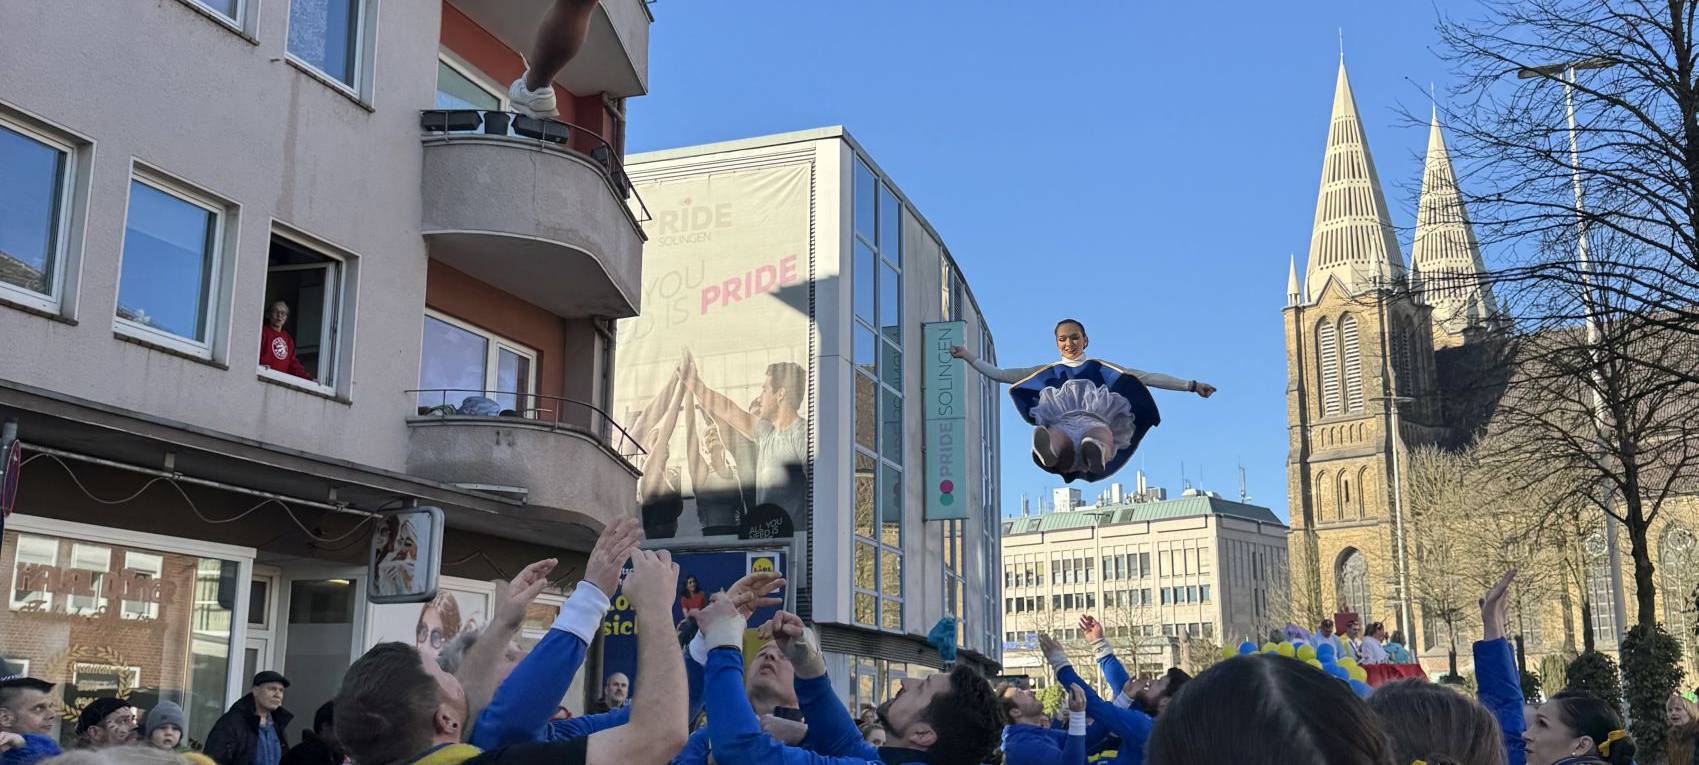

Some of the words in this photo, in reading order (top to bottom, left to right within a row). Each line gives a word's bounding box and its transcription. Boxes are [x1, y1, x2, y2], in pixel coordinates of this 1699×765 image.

[657, 232, 711, 248] SOLINGEN
[645, 259, 705, 306] YOU
[701, 254, 798, 315] PRIDE
[938, 328, 953, 417] SOLINGEN
[939, 423, 953, 477] PRIDE
[766, 517, 783, 530] YOU
